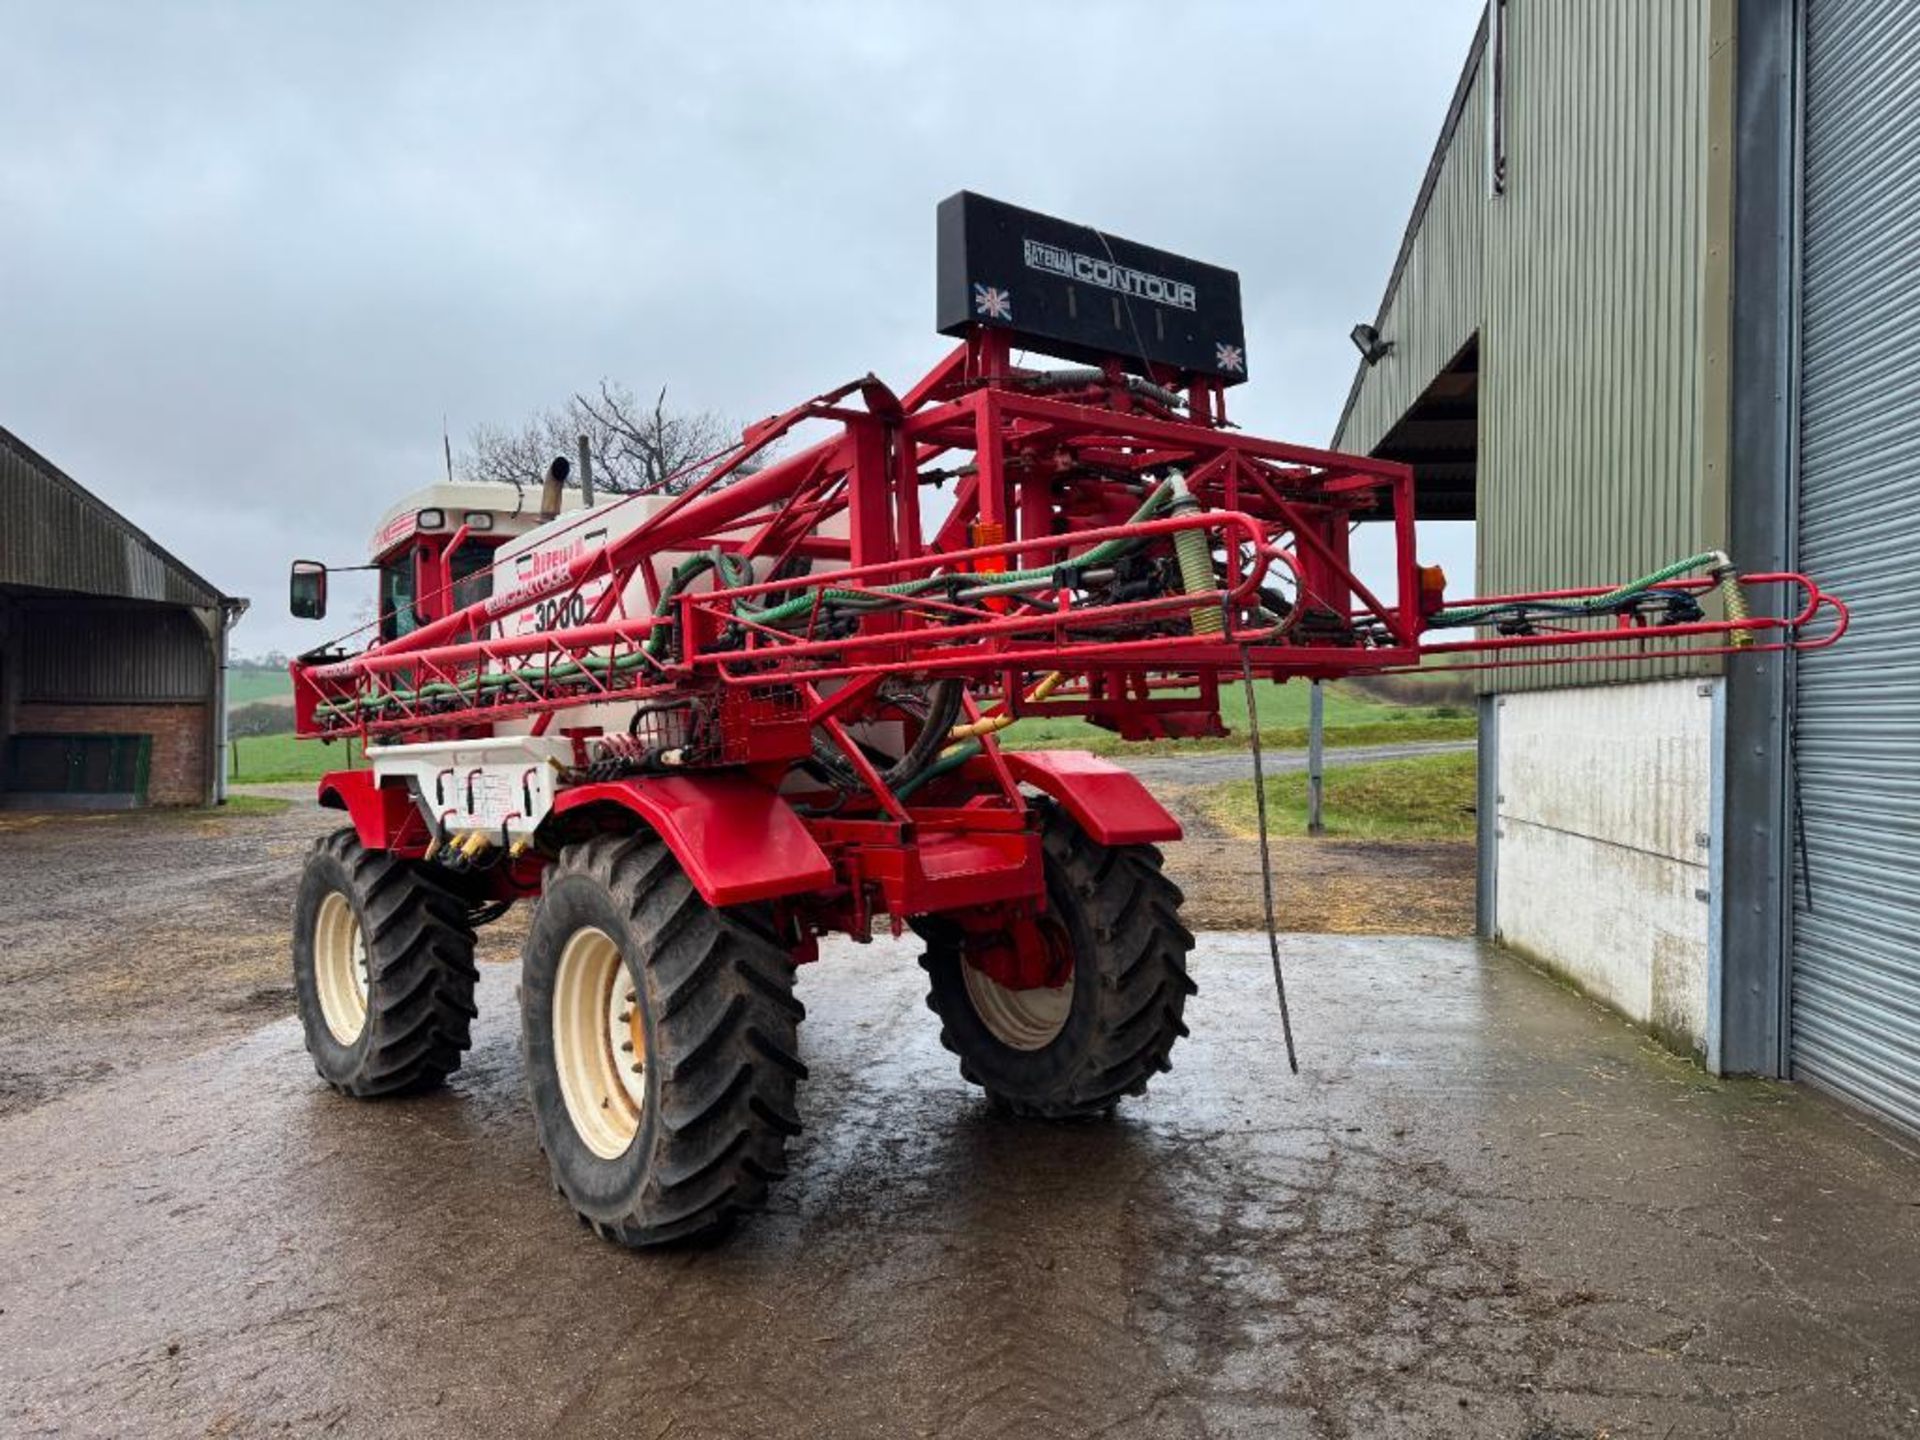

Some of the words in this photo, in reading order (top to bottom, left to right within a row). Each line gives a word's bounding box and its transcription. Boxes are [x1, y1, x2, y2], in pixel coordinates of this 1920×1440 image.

[1024, 239, 1074, 278] BATEMAN
[1074, 254, 1196, 311] CONTOUR
[535, 593, 584, 632] 3000
